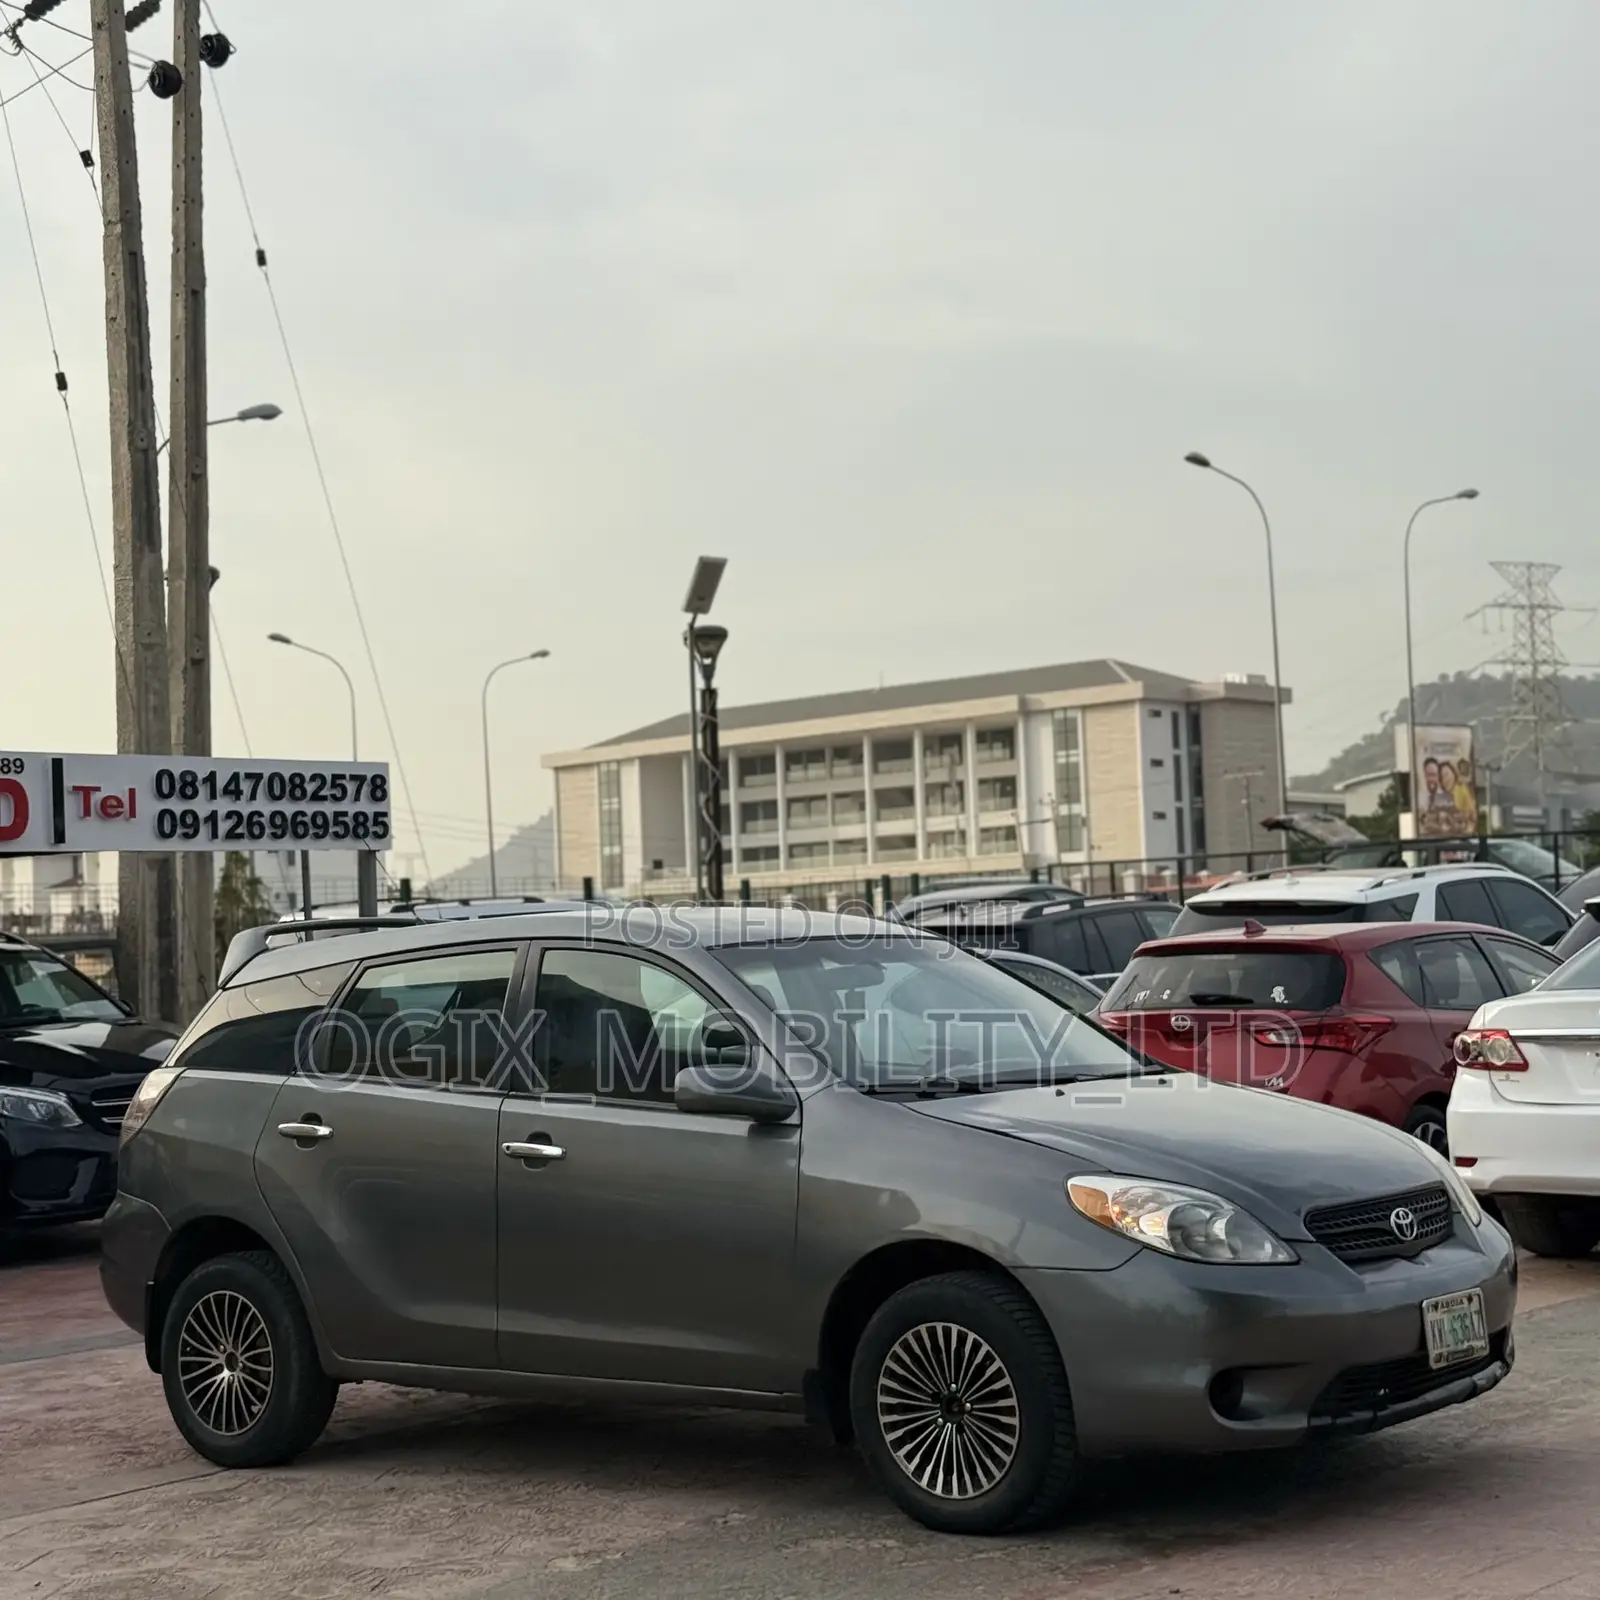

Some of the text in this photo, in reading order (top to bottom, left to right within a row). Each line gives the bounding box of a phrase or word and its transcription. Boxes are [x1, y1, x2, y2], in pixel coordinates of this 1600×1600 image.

[71, 785, 137, 819] Tel
[154, 768, 388, 802] 08147082578
[156, 808, 390, 841] 09126969585
